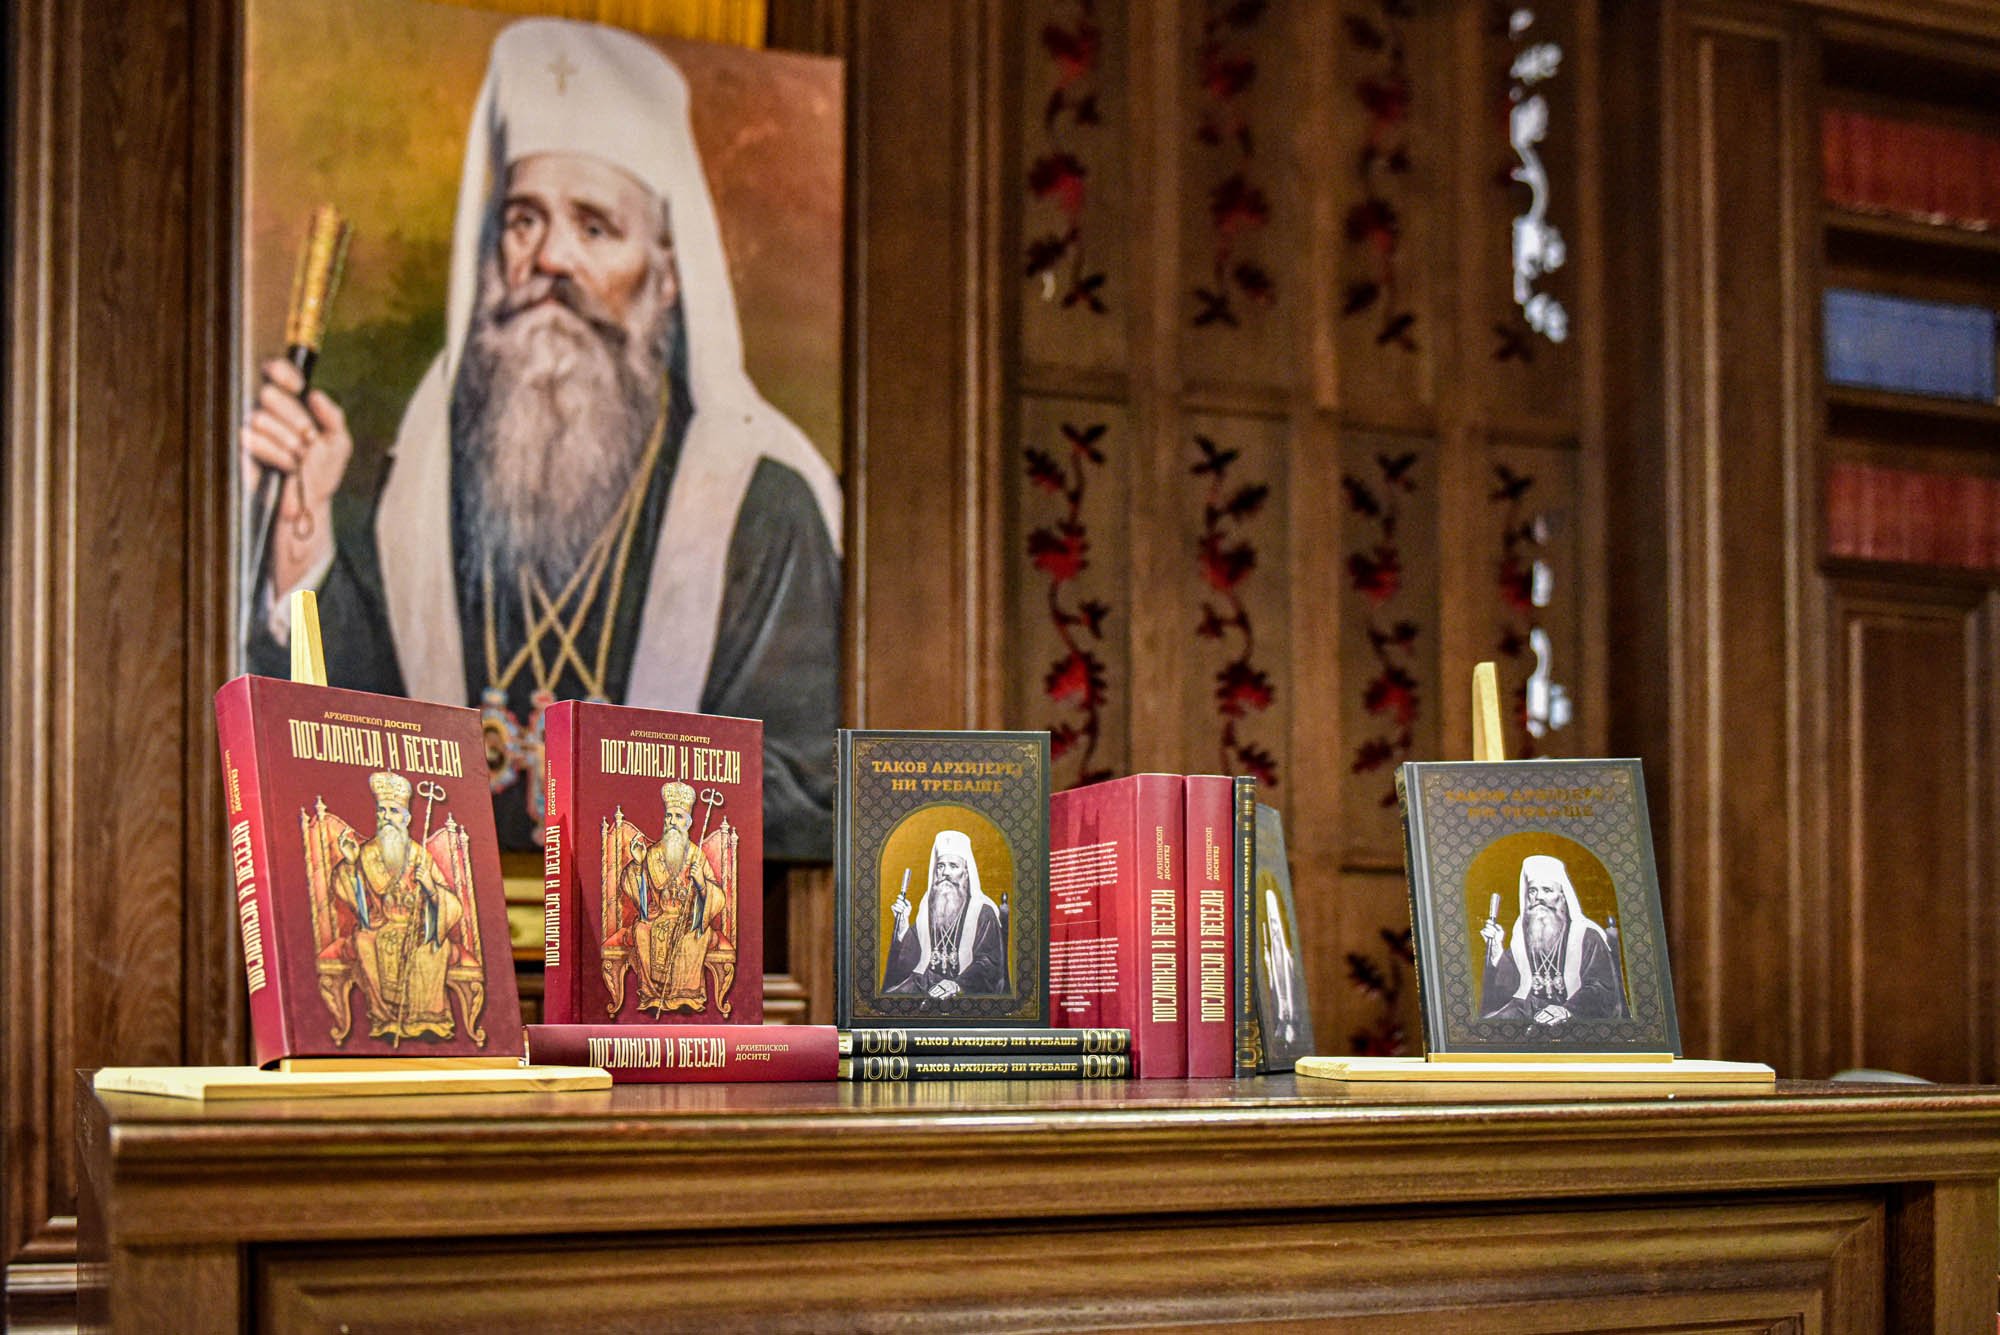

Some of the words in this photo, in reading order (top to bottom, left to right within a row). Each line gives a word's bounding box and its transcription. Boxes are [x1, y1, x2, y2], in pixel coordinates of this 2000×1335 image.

[323, 711, 383, 726] АРХИЕПИСКОП
[384, 719, 421, 732] ДОСИТЕЈ
[630, 729, 679, 741] АРХИЕПИСКОП
[679, 734, 710, 745] ДОСИТЕЈ
[288, 719, 384, 768] ПОСЛАНИЈА
[386, 733, 400, 770] И
[402, 734, 463, 778] БЕСЕДИ
[601, 738, 675, 779] ПОСЛАНИЈА
[680, 747, 689, 780] И
[693, 748, 741, 785] БЕСЕДИ
[871, 761, 927, 774] ТАКОВ
[931, 761, 1025, 777] АРХИЈЕРЕЈ
[891, 779, 917, 791] НИ
[921, 779, 1003, 792] ТРЕБАШЕ
[232, 819, 255, 887] БЕСЕДИ
[546, 825, 560, 876] БЕСЕДИ
[1156, 826, 1164, 880] АРХИЕПИСКОП
[1164, 844, 1172, 880] ДОСИТЕЈ
[239, 883, 256, 902] И
[546, 879, 560, 889] И
[1151, 889, 1176, 936] БЕСЕДИ
[1200, 889, 1224, 936] БЕСЕДИ
[545, 892, 560, 967] ПОСЛАНИЈА
[1151, 940, 1176, 949] И
[1200, 940, 1224, 949] И
[240, 899, 267, 995] ПОСЛАНИЈА
[1151, 953, 1177, 1023] ПОСЛАНИЈА
[1200, 953, 1225, 1023] ПОСЛАНИЈА
[588, 1037, 661, 1068] ПОСЛАНИЈА
[665, 1037, 674, 1068] И
[678, 1037, 726, 1068] БЕСЕДИ
[735, 1043, 789, 1052] АРХИЕПИСКОП
[735, 1052, 770, 1061] ДОСИТЕЈ
[914, 1036, 949, 1046] ТАКОВ
[951, 1036, 1008, 1048] АРХИЈЕРЕЈ
[1010, 1036, 1026, 1046] НИ
[1028, 1036, 1078, 1046] ТРЕБАШЕ
[915, 1062, 951, 1072] ТАКОВ
[952, 1062, 1009, 1074] АРХИЈЕРЕЈ
[1011, 1062, 1027, 1072] НИ
[1028, 1062, 1078, 1072] ТРЕБАШЕ
